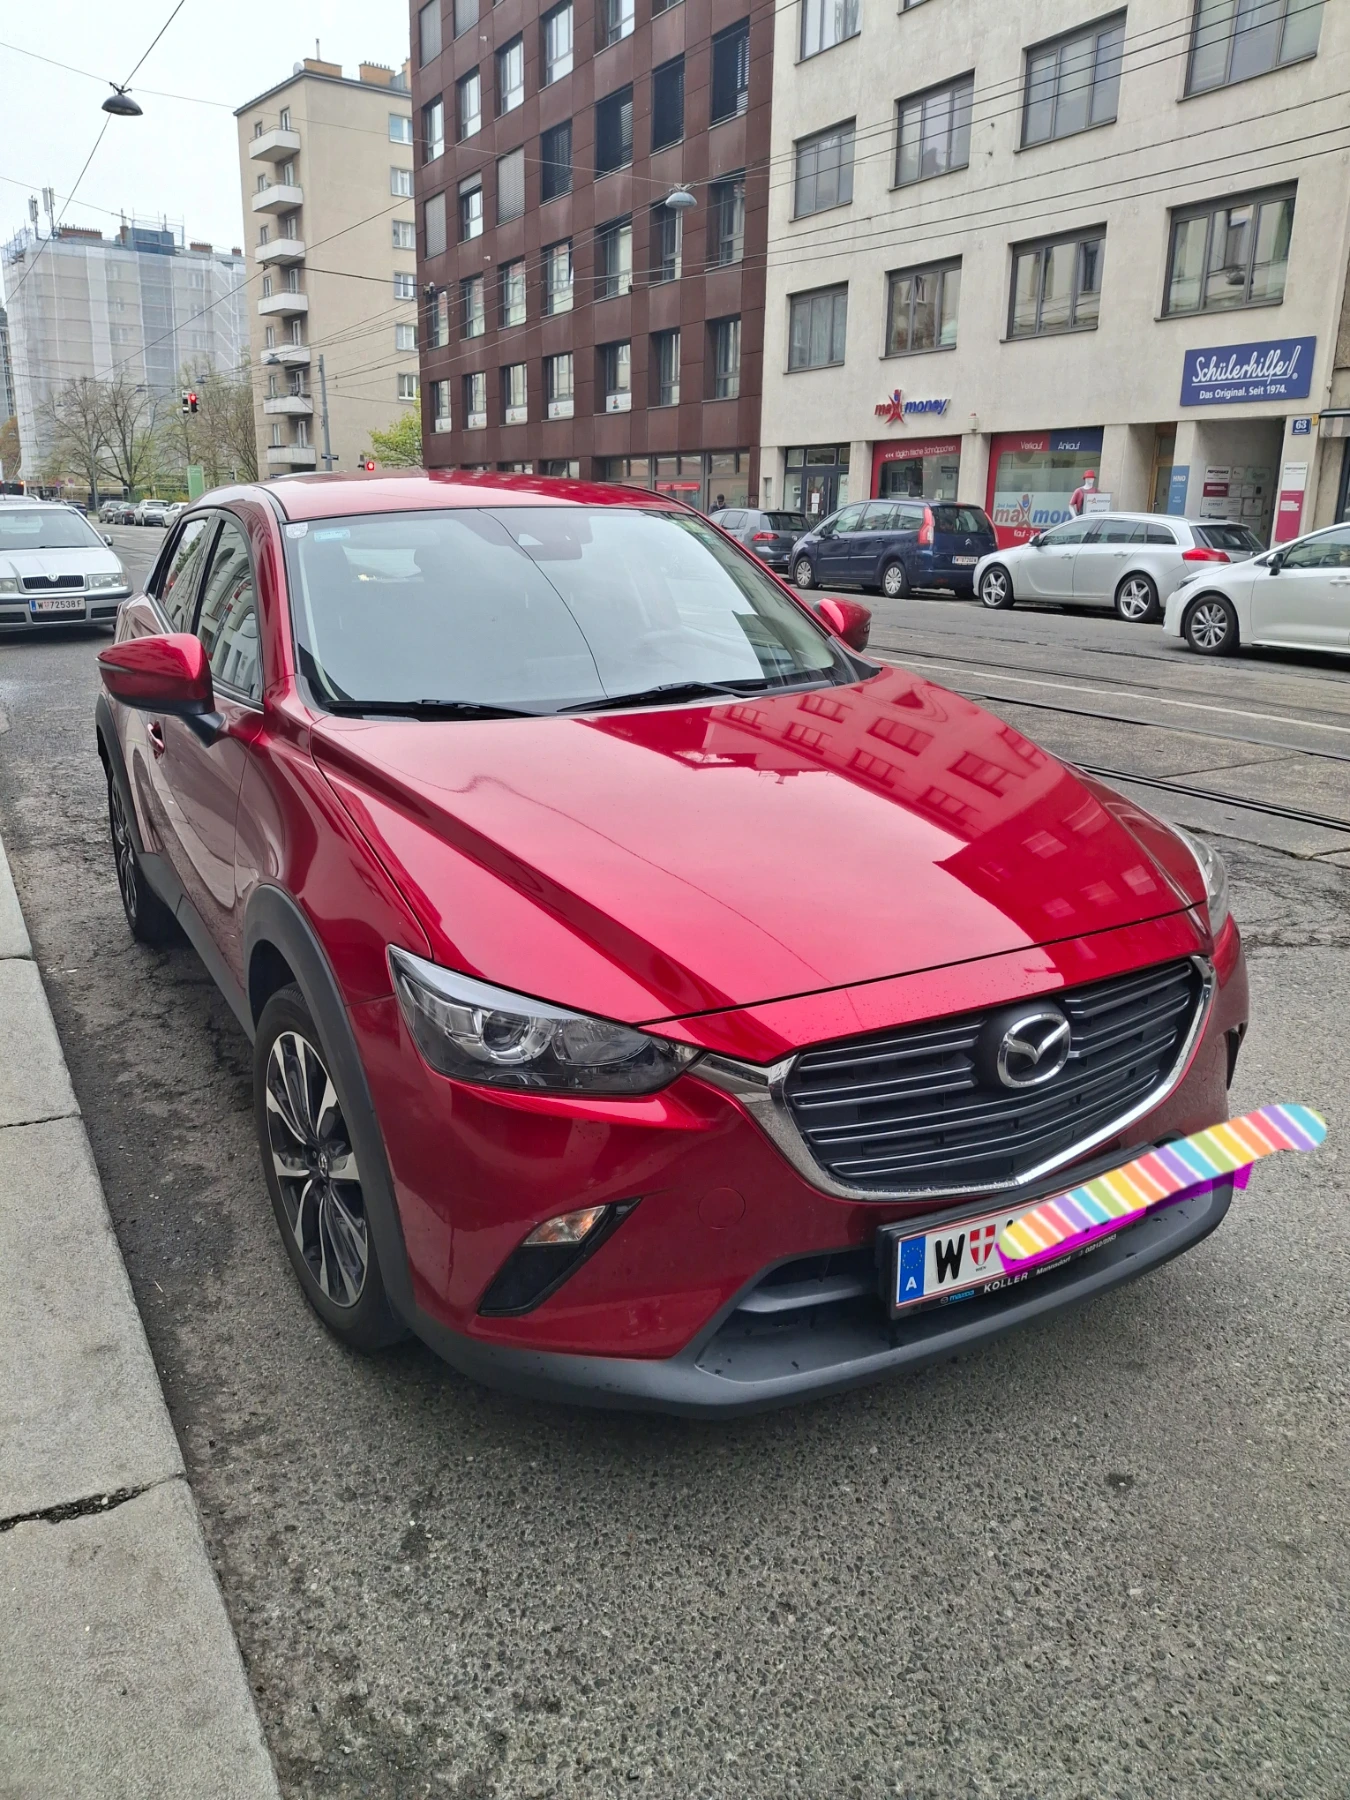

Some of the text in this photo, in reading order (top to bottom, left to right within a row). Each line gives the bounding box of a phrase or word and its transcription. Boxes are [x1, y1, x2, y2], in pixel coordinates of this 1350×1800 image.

[1199, 384, 1287, 399] Das Original. Seit 1974.
[1295, 420, 1307, 429] 63
[1020, 441, 1081, 450] Verkauf Ankauf
[1032, 509, 1072, 523] mon
[935, 1233, 966, 1284] W
[983, 1272, 1029, 1294] KOLLER
[1036, 1256, 1071, 1275] Mannsdorf
[905, 1276, 918, 1291] A
